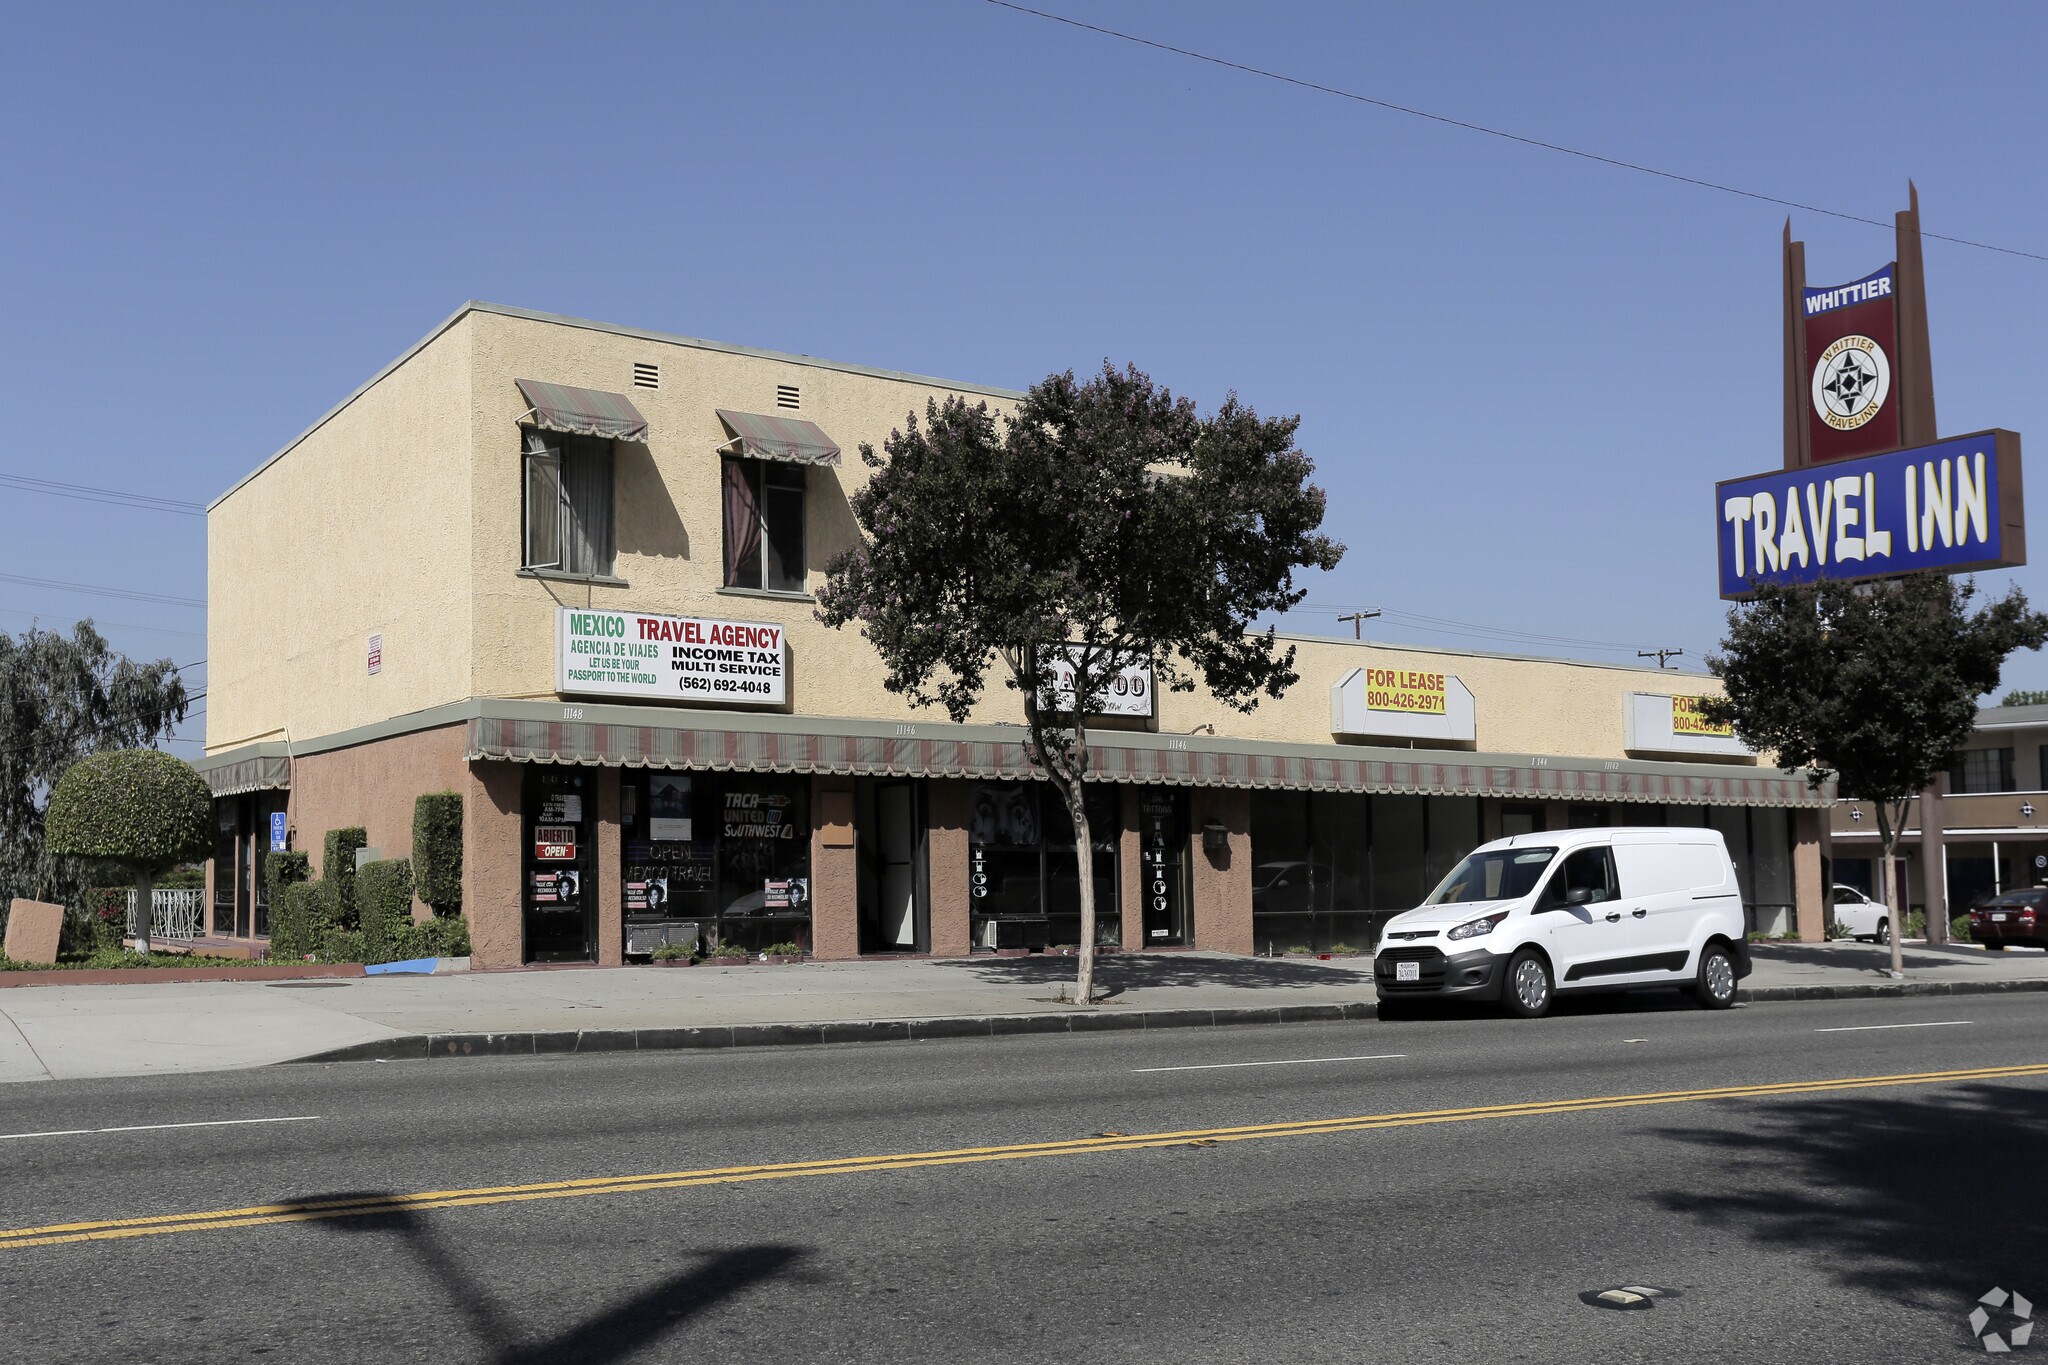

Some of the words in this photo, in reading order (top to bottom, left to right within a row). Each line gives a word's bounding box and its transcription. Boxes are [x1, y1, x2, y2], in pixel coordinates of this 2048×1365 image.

[1806, 276, 1892, 314] WHITTIER
[1823, 337, 1875, 362] WHITTIER
[1824, 402, 1879, 430] TRAVEL-INN
[1724, 471, 1892, 578] TRAVEL
[1904, 452, 1989, 553] INN
[570, 613, 625, 638] MEXICO
[637, 618, 706, 645] TRAVEL
[709, 624, 780, 650] AGENCY
[570, 639, 611, 656] AGENCIA
[614, 642, 626, 657] DE
[628, 643, 659, 659] VIAJES
[672, 647, 744, 663] INCOME
[747, 651, 780, 665] TAX
[589, 657, 601, 668] LET
[601, 659, 611, 669] US
[612, 659, 620, 670] BE
[621, 660, 640, 671] YOUR
[671, 661, 716, 673] MULTI
[719, 663, 781, 677] SERVICE
[568, 669, 606, 682] PASSPORT
[606, 671, 616, 683] TO
[617, 672, 630, 684] THE
[631, 673, 657, 685] WORLD
[679, 676, 711, 692] (562)
[713, 679, 771, 694] 692-4048
[1043, 669, 1146, 697] TAOO
[1366, 668, 1396, 688] FOR
[1400, 671, 1445, 692] LEASE
[1367, 690, 1445, 711] 800-426-2971
[1672, 697, 1696, 714] FOR
[563, 707, 584, 720] 11148
[896, 724, 916, 736] 11146
[1169, 739, 1187, 750] 11146
[725, 792, 760, 808] TACA
[724, 810, 765, 823] UNITED
[537, 828, 574, 843] ABIERTO
[724, 824, 782, 838] SOUTHWEST
[650, 844, 691, 860] OPEN
[672, 866, 713, 882] TRAVEL
